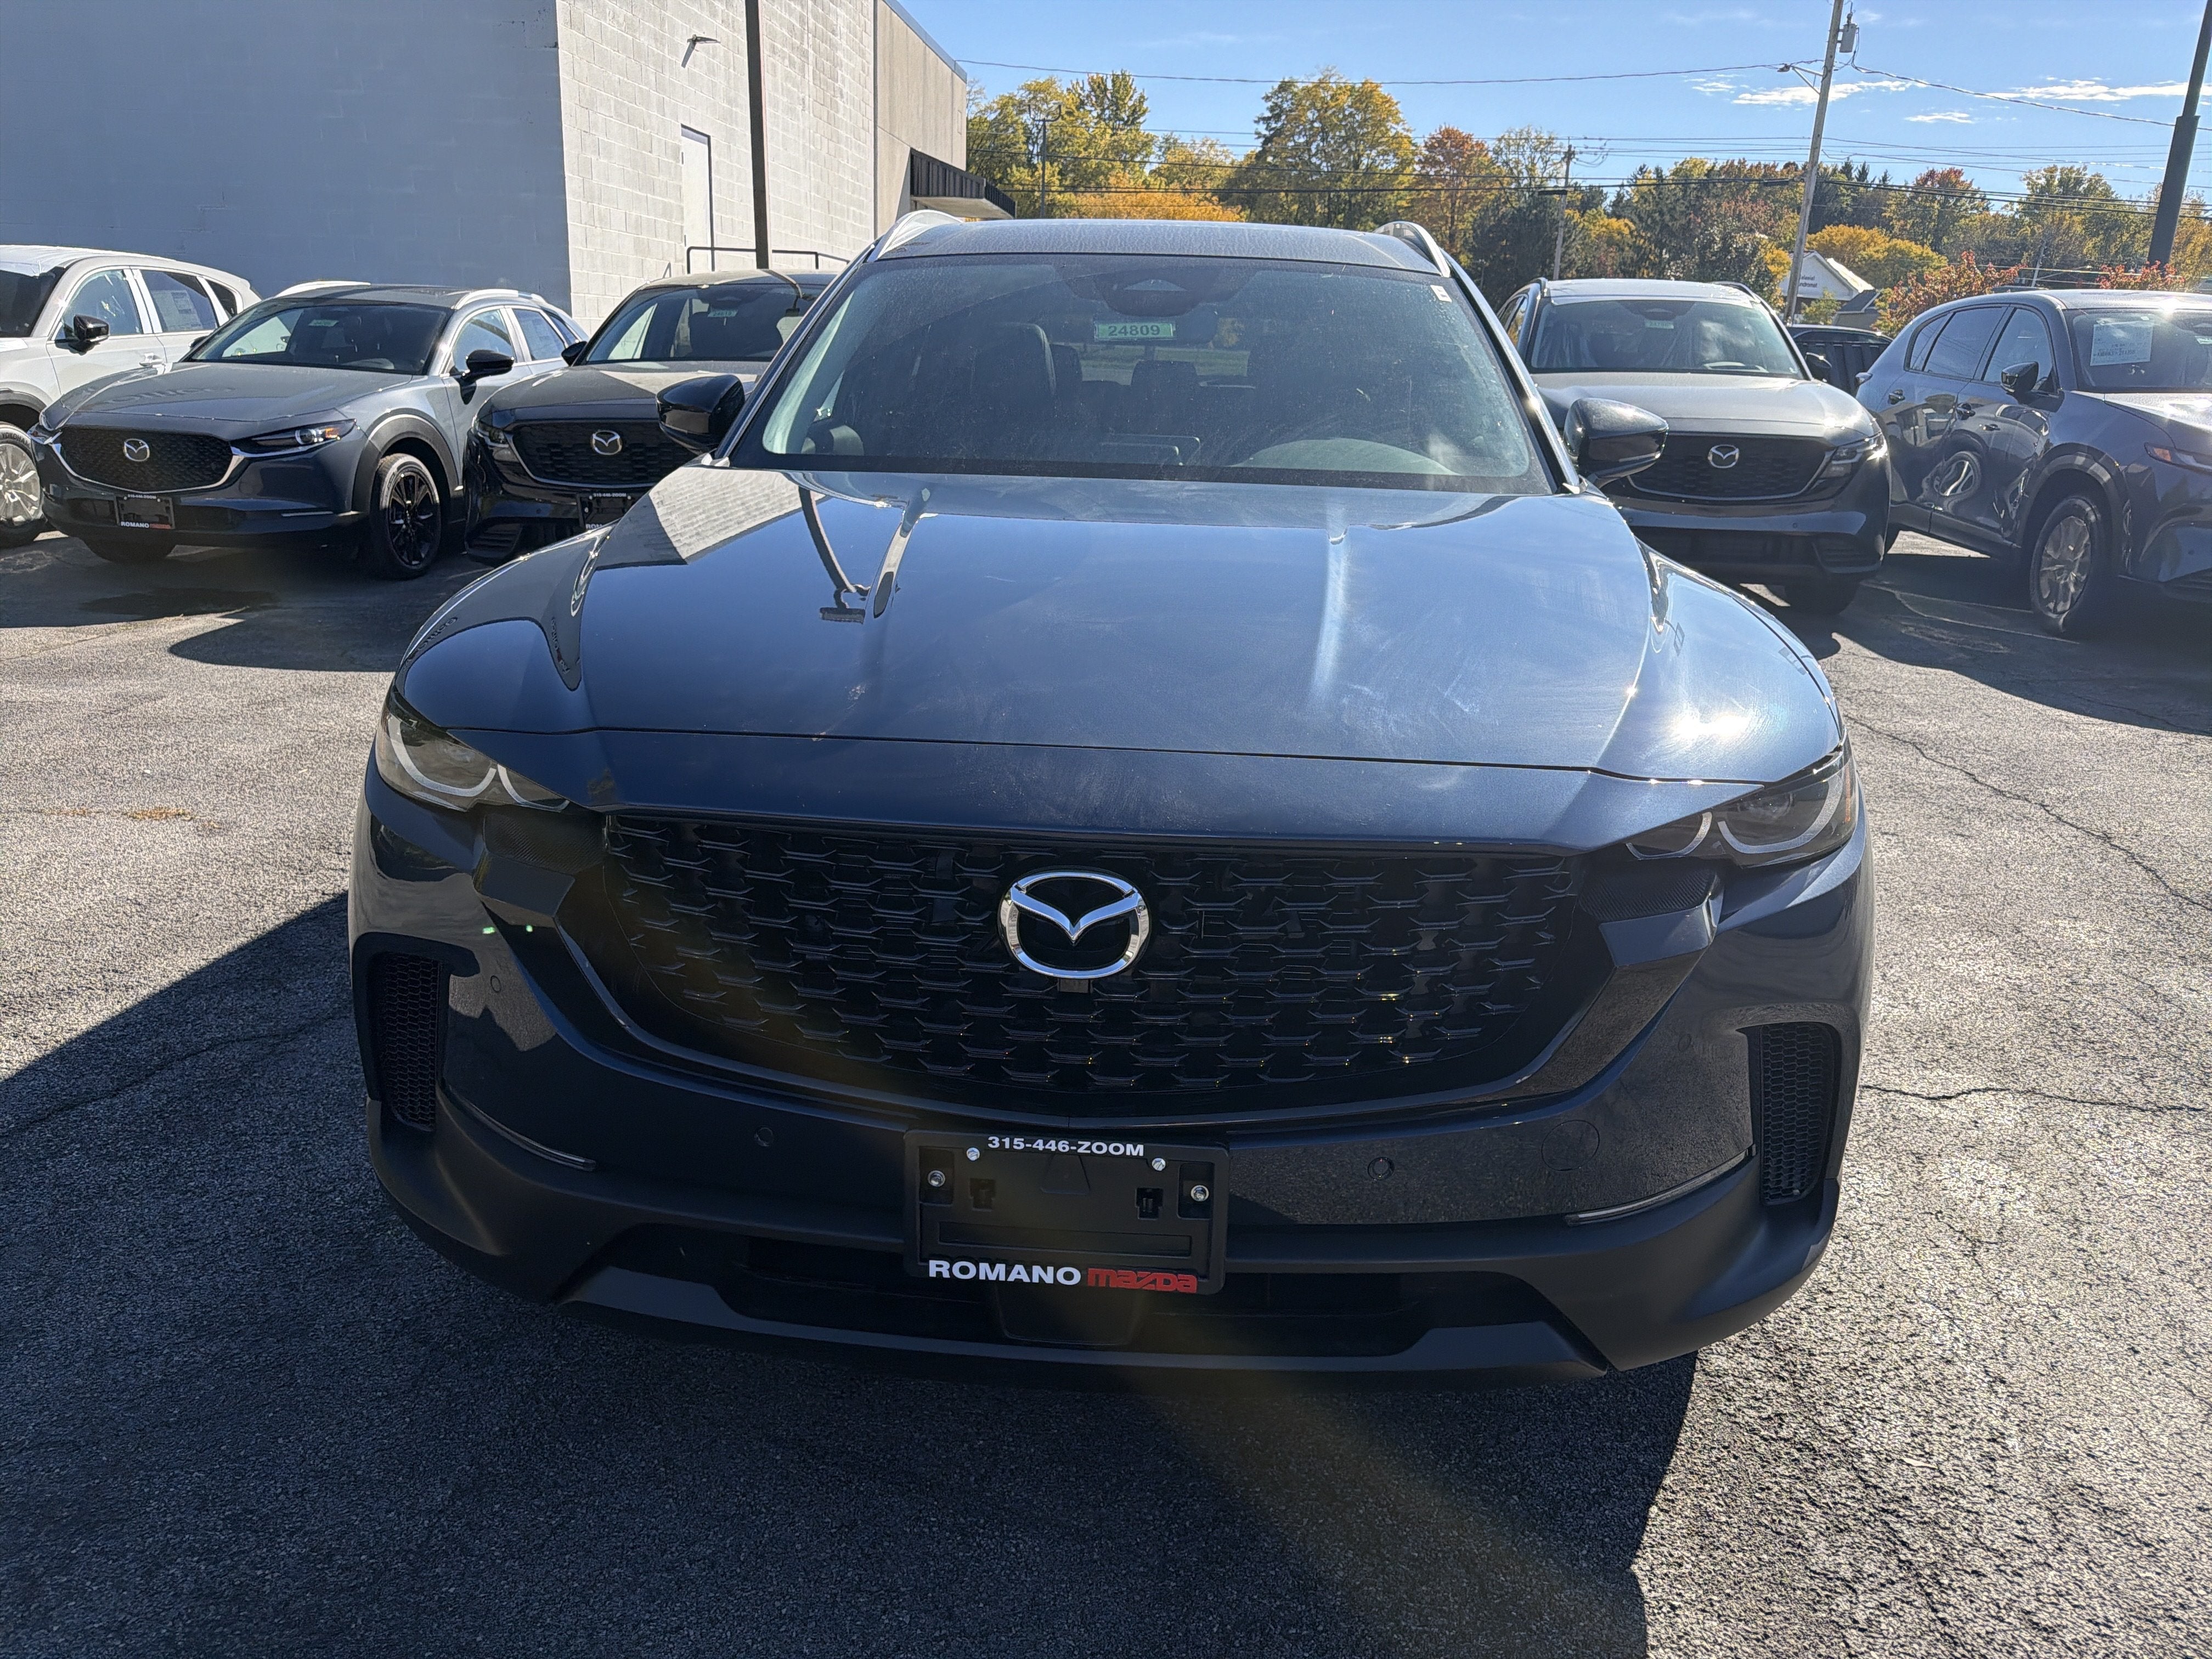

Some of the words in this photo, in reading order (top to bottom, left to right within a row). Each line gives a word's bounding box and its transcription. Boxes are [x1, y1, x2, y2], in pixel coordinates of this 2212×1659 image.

[1108, 324, 1161, 336] 24809
[988, 1136, 1144, 1158] 315-446-ZOOM
[929, 1259, 1082, 1286] ROMANO
